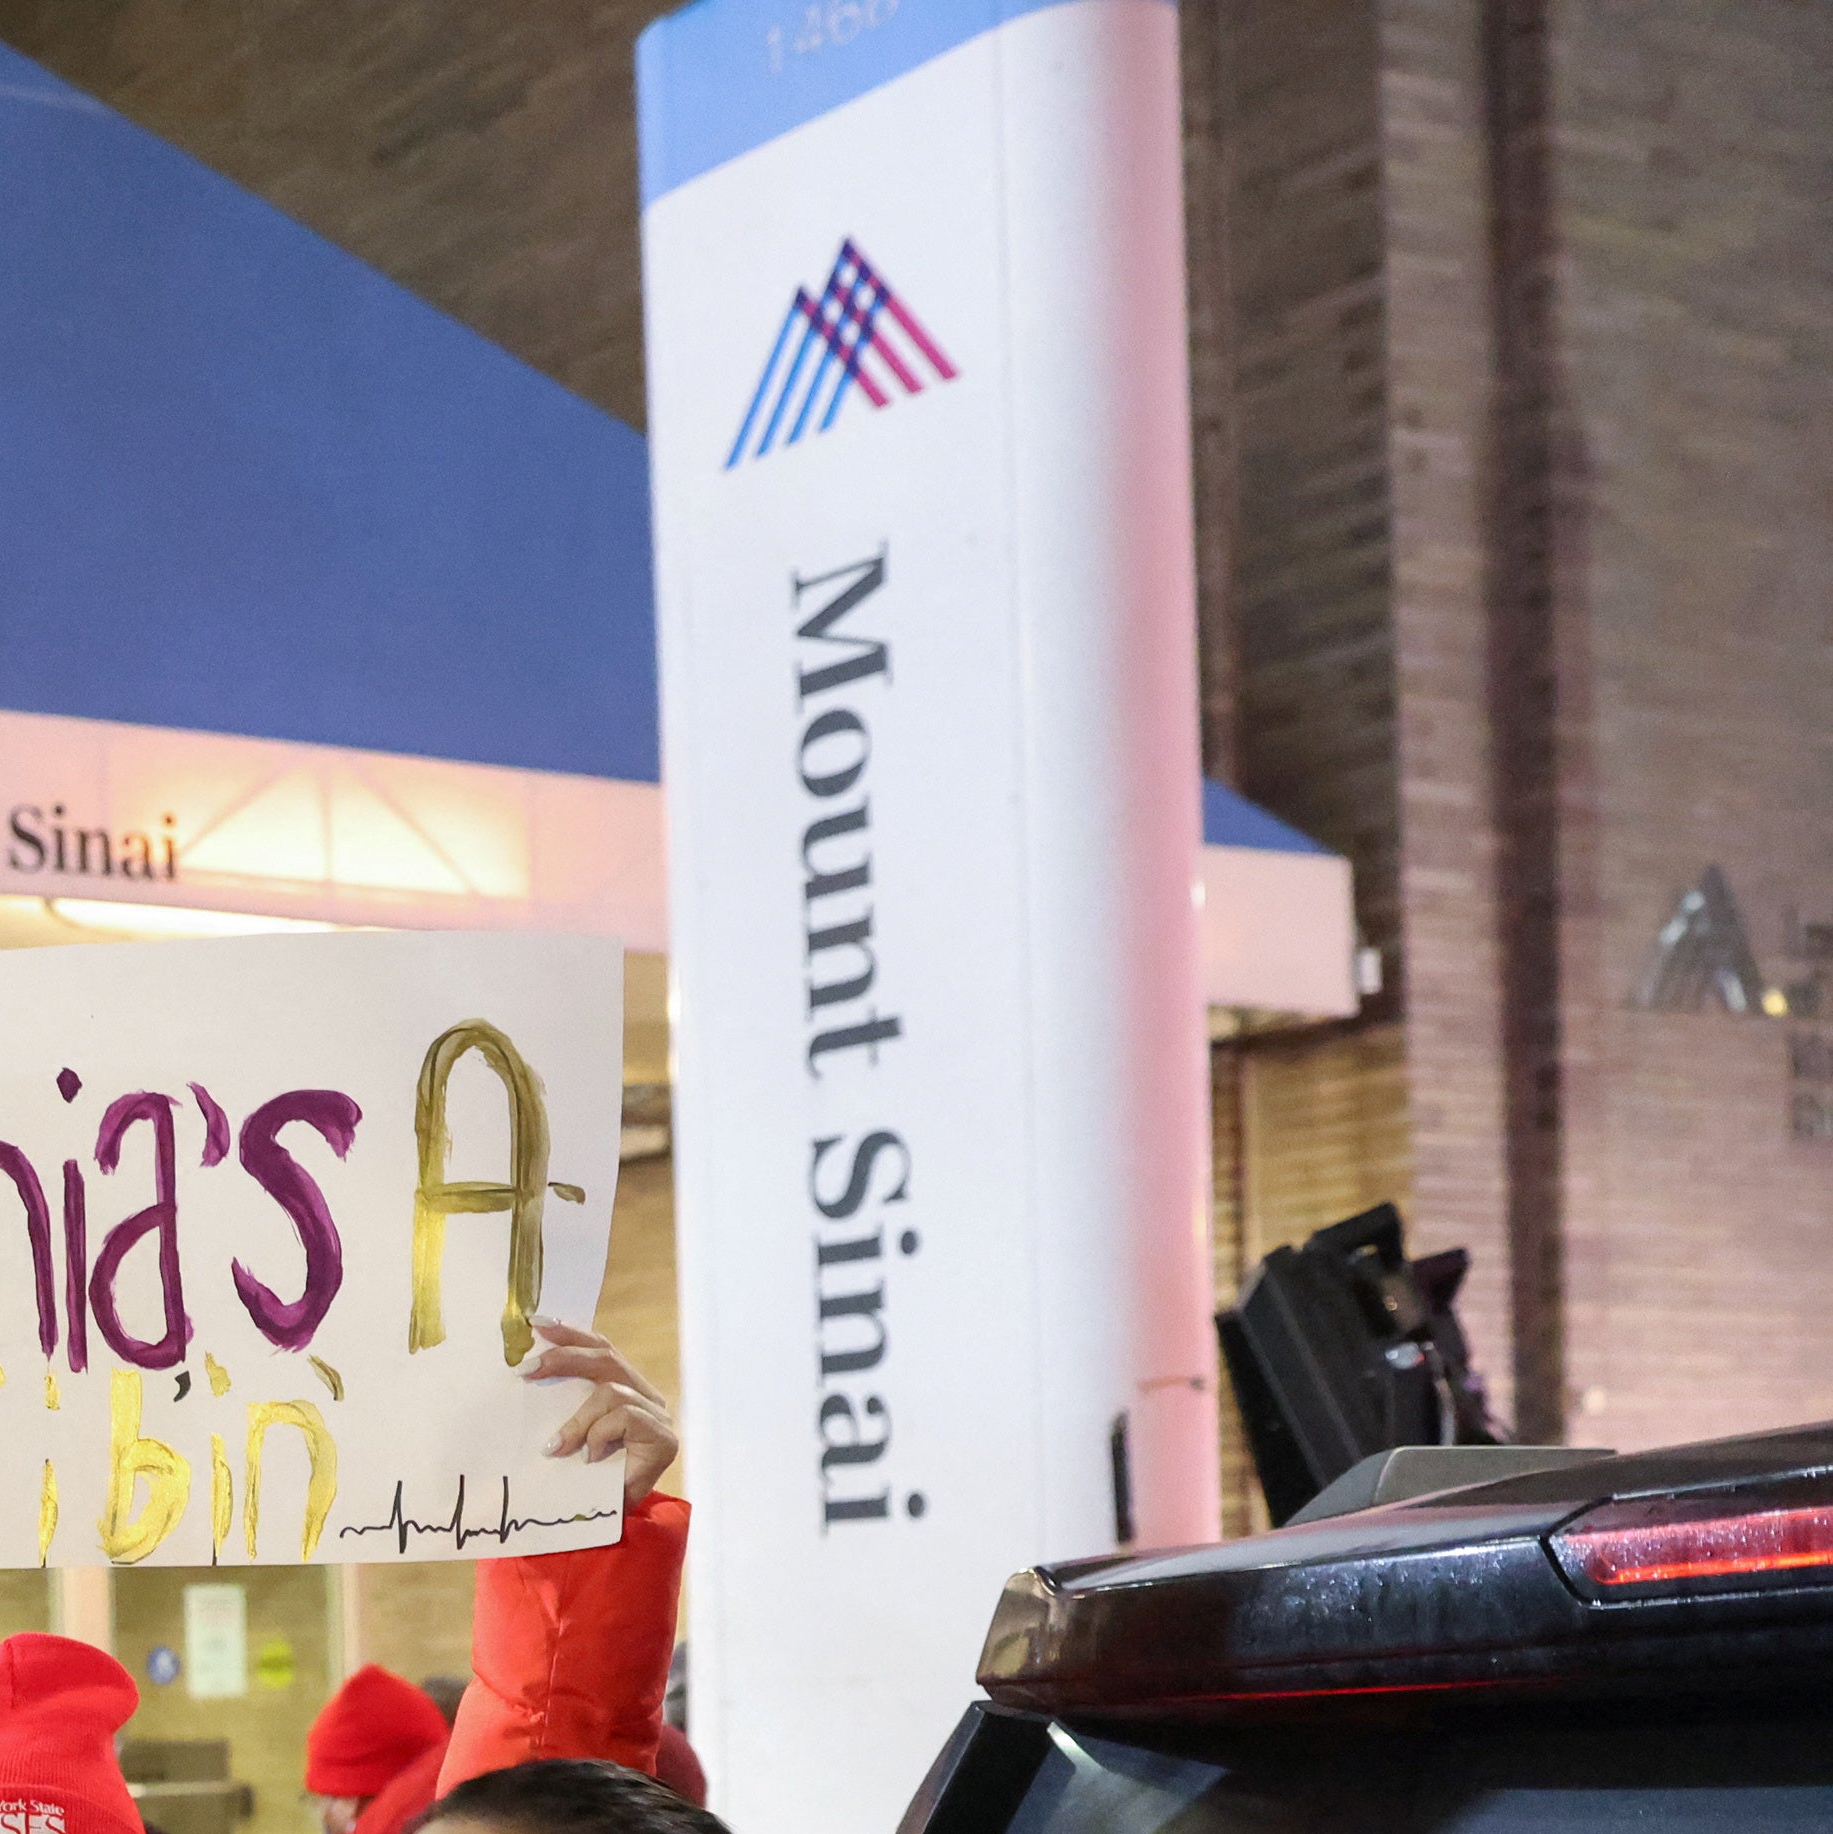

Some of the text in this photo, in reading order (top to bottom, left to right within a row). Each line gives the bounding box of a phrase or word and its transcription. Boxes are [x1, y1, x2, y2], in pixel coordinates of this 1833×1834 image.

[7, 802, 181, 885] Sinai
[791, 540, 930, 1538] Mount Sinai
[29, 1799, 65, 1817] State
